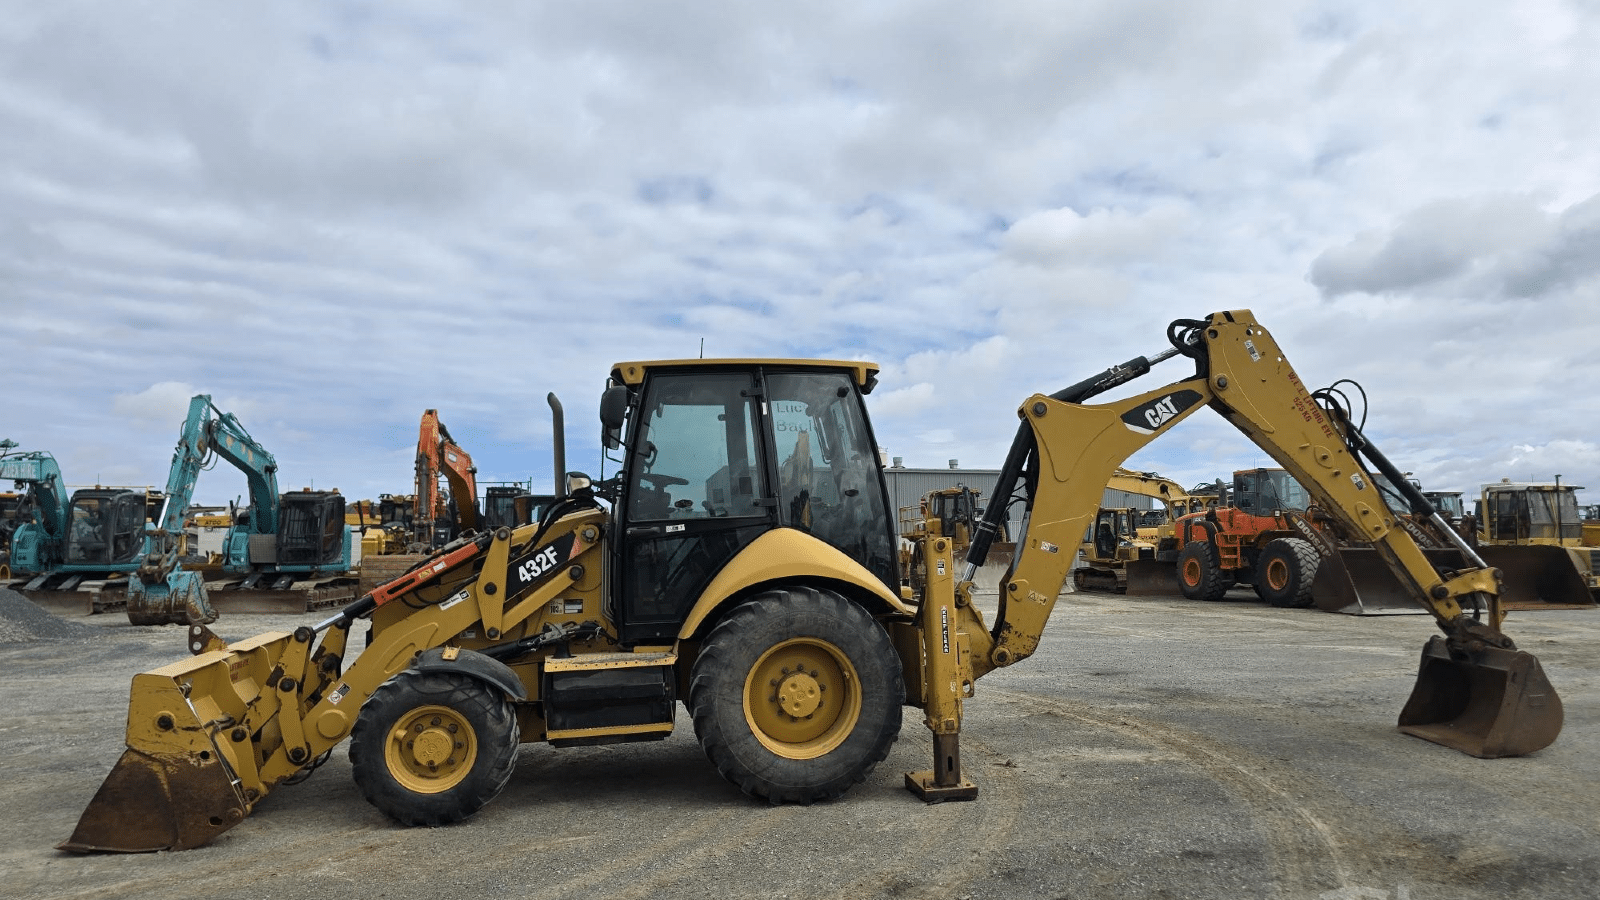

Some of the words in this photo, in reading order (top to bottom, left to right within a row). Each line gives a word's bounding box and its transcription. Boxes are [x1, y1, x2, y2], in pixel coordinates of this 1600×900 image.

[776, 402, 802, 413] Luc
[1144, 395, 1178, 428] CAT
[1301, 410, 1313, 422] KG
[1302, 395, 1324, 424] LIFTING
[1321, 423, 1334, 439] EYE
[1406, 523, 1433, 547] DOOS
[518, 545, 558, 583] 432F
